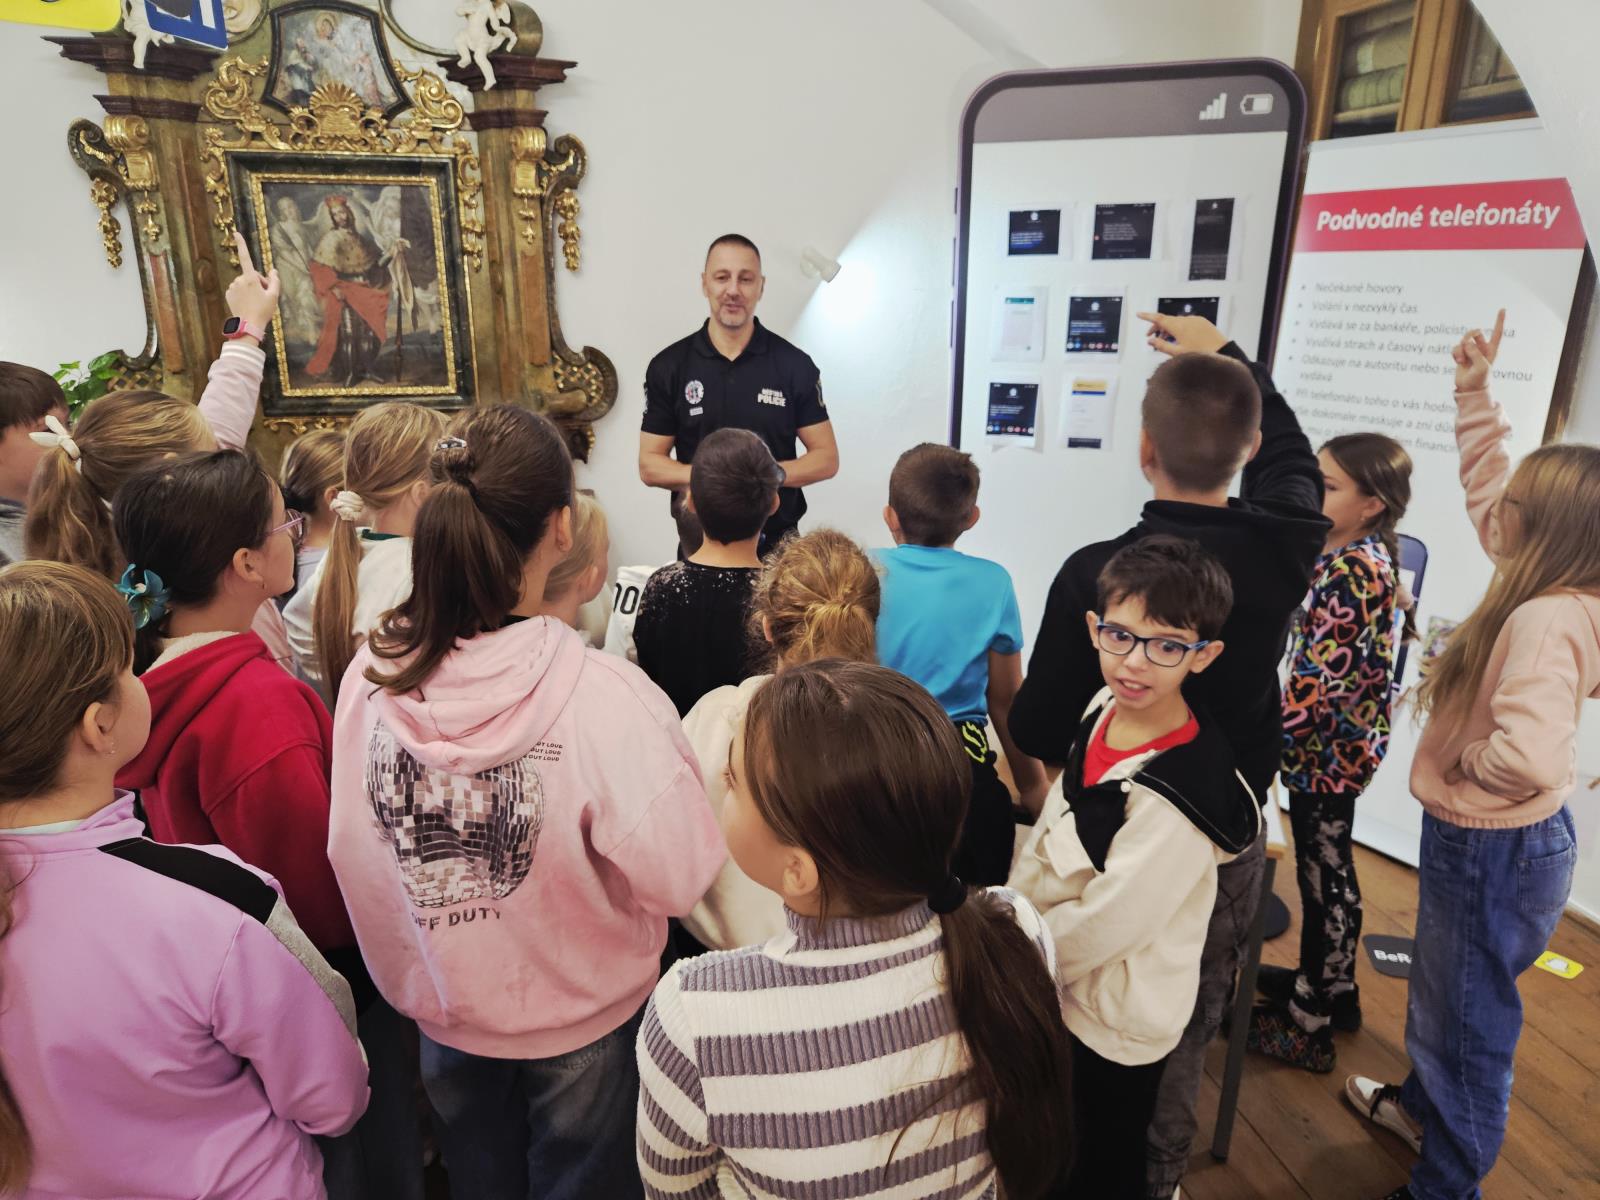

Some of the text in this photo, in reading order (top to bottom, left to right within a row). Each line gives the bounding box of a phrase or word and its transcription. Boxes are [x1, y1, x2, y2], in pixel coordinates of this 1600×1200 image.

[1316, 200, 1561, 232] Podvodné telefonáty
[1315, 282, 1403, 295] Nečekané hovory
[1352, 302, 1397, 315] nezvyklý
[1399, 302, 1418, 313] čas
[1423, 323, 1468, 335] policist
[1386, 340, 1424, 354] časový
[1364, 360, 1408, 372] autoritu
[1410, 362, 1439, 373] nebo
[1492, 369, 1533, 382] ovnou
[1423, 401, 1456, 414] hodn
[411, 907, 501, 931] FF DUTY
[1373, 949, 1413, 965] BeR
